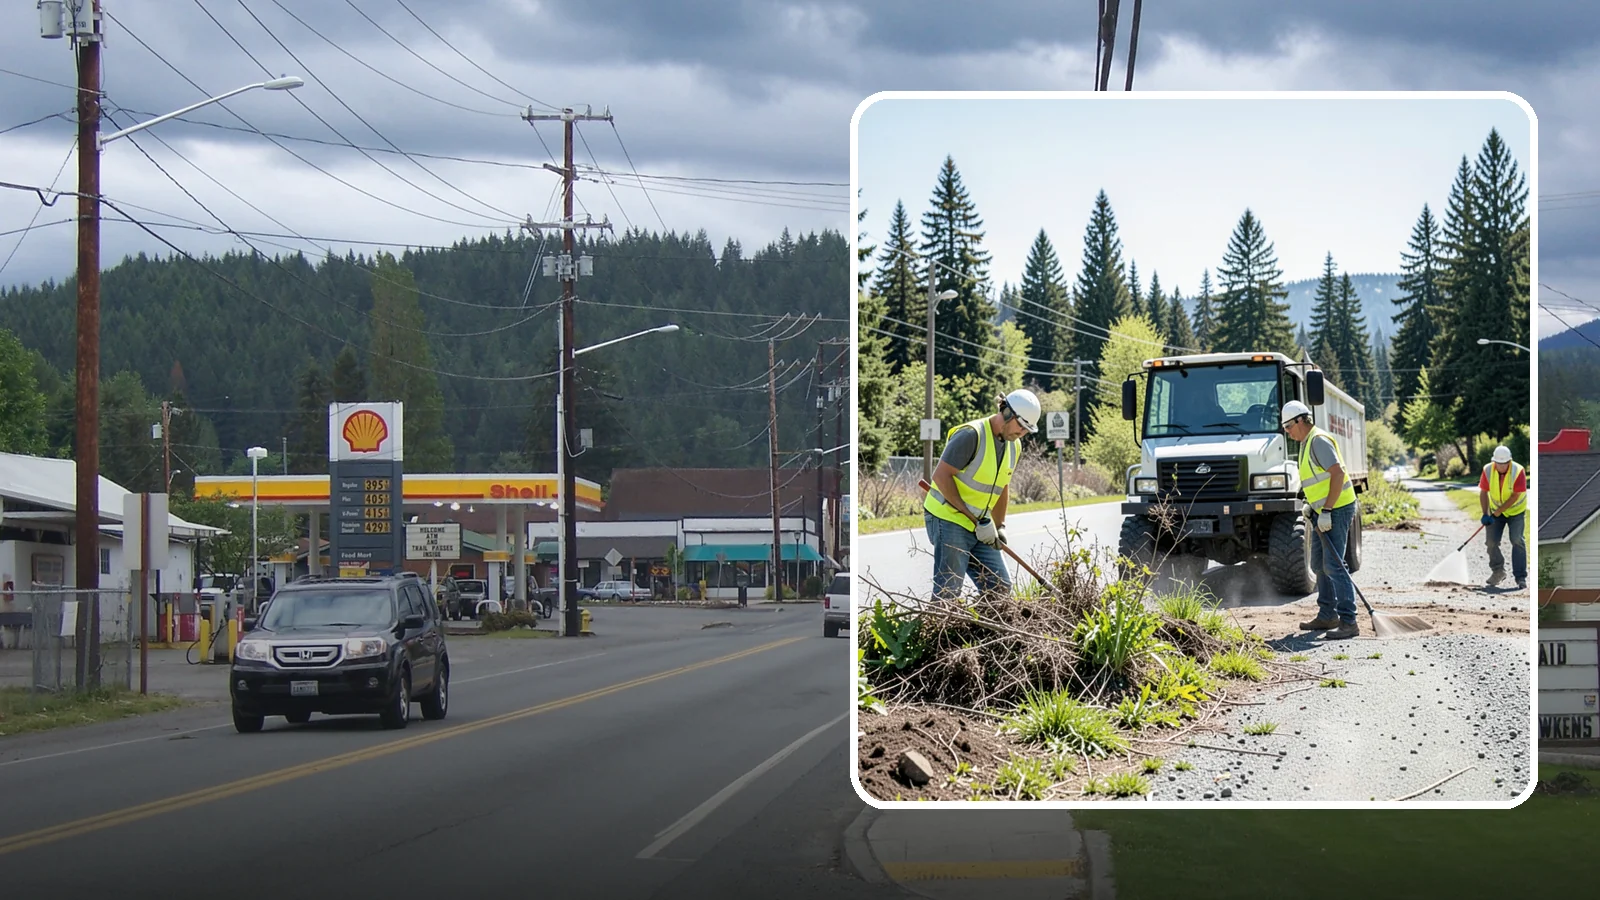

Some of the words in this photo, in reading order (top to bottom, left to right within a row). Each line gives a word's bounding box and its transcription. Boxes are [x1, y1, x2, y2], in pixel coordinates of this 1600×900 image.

[366, 480, 383, 490] 395
[490, 484, 547, 499] Shell
[365, 494, 383, 504] 405
[365, 508, 383, 518] 415
[365, 522, 383, 533] 429
[1538, 642, 1567, 665] AID
